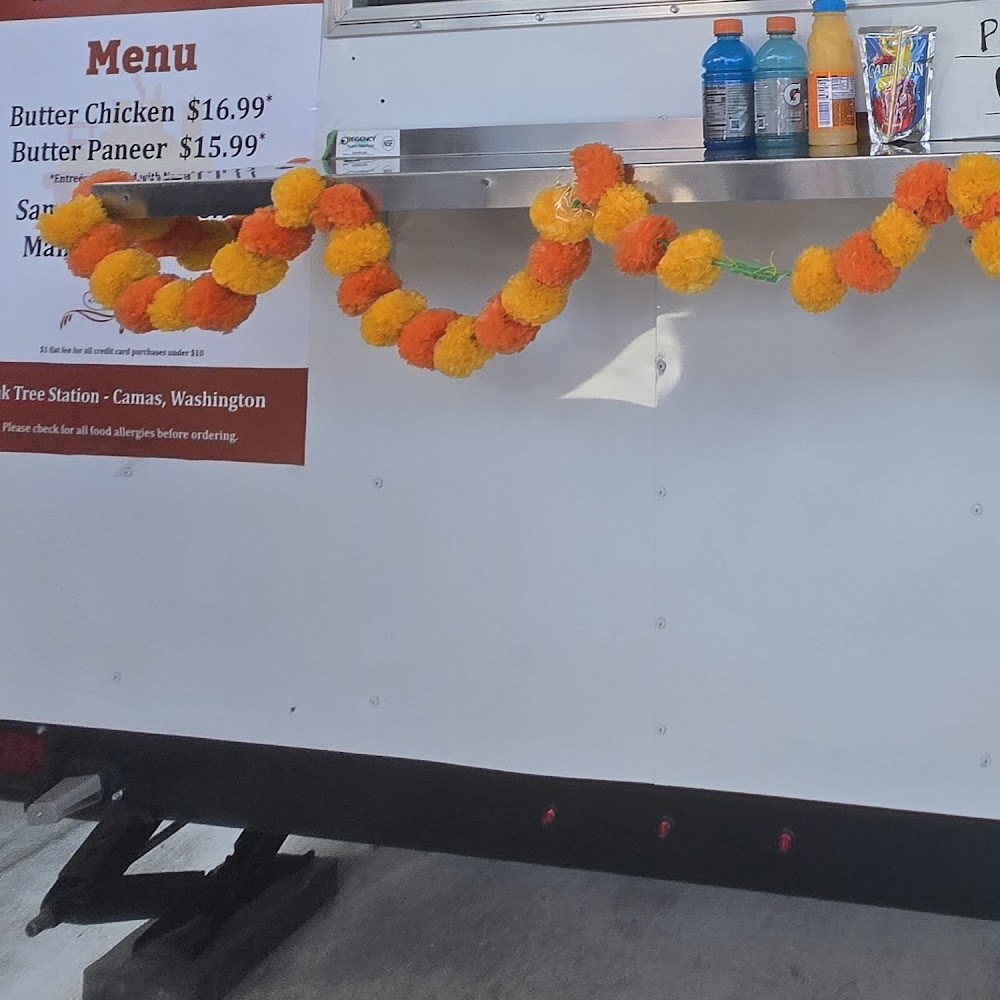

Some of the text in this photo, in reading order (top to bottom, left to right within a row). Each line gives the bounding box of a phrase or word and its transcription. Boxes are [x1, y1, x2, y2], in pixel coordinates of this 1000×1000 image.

[86, 39, 198, 76] Menu
[868, 63, 898, 78] CAPR
[9, 104, 78, 128] Butter
[85, 100, 175, 125] Chicken
[11, 139, 81, 163] Butter
[86, 139, 168, 162] Paneer
[84, 346, 93, 355] all
[94, 347, 113, 355] credit
[115, 347, 130, 355] card
[131, 348, 167, 358] purchases
[168, 348, 189, 357] under
[190, 349, 204, 357] $10
[13, 385, 45, 402] Tree
[48, 386, 100, 404] Station
[113, 389, 167, 408] Camas,
[170, 390, 266, 412] Washington
[2, 421, 239, 444] Please check for all food allergies before ordering.
